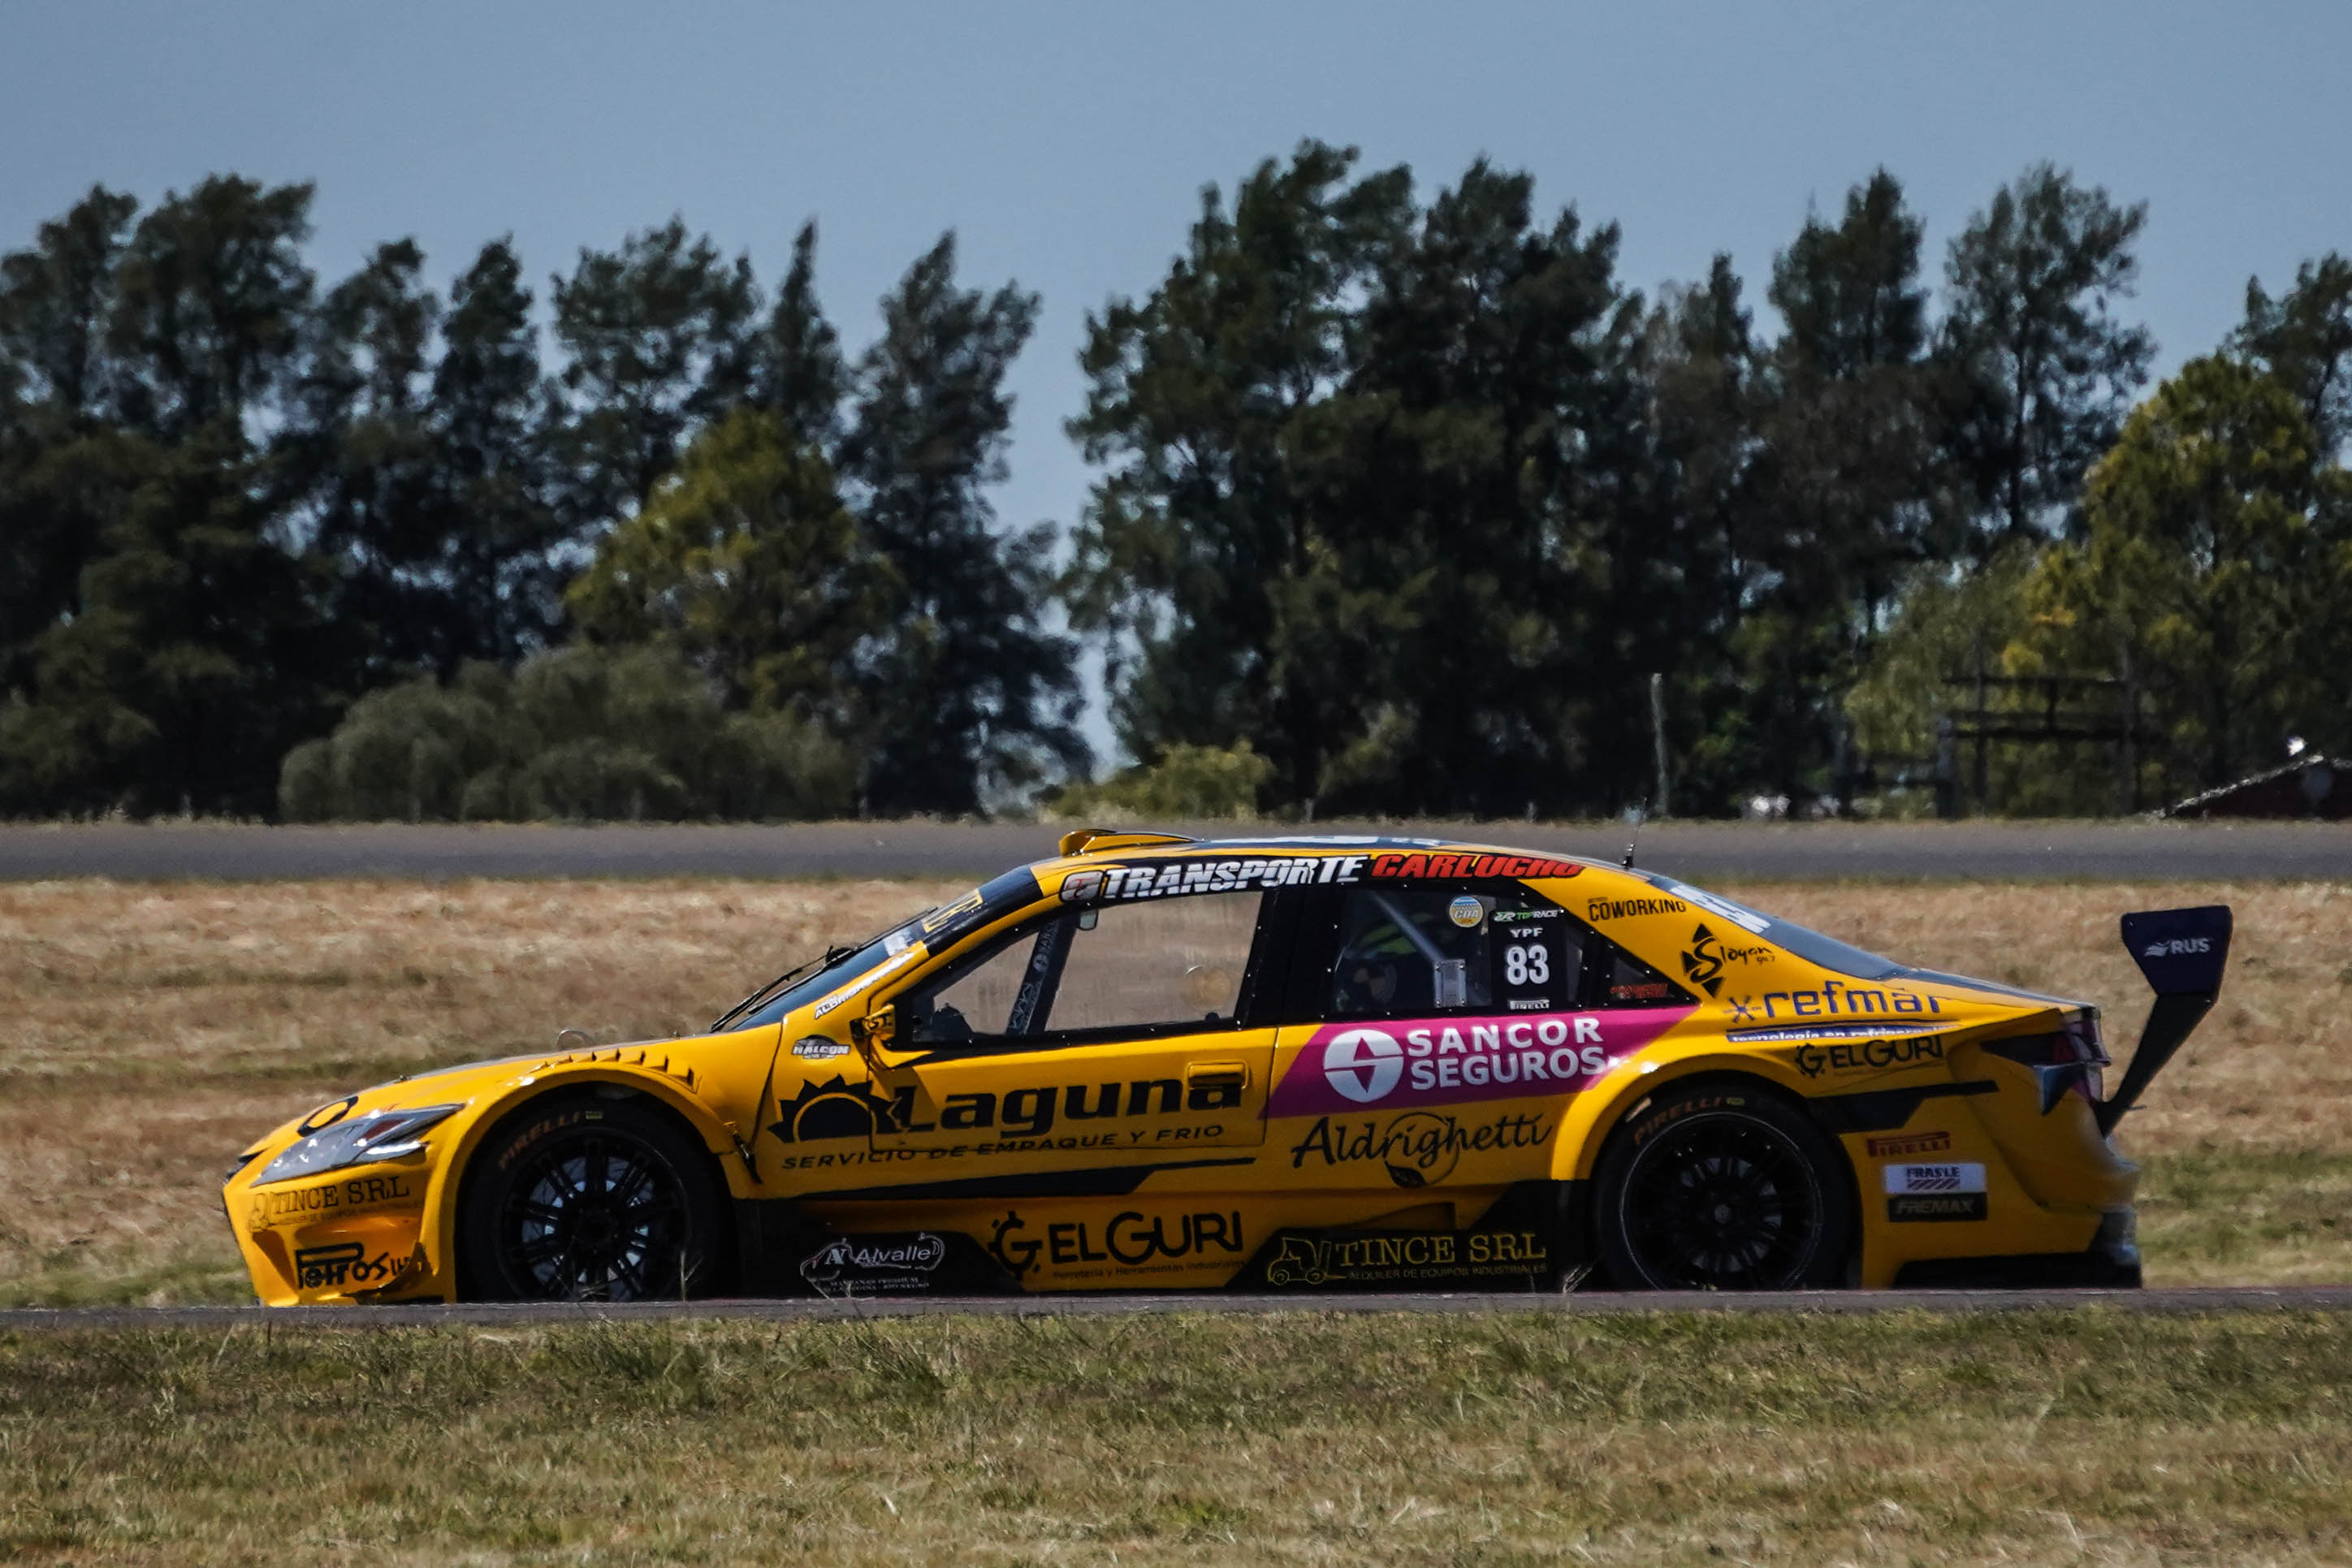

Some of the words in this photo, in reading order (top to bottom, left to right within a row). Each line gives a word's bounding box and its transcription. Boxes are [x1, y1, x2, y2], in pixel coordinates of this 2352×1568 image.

[1104, 856, 1369, 900] TRANSPORTE
[1371, 853, 1585, 879] CARLUCHO
[1589, 899, 1686, 922] COWORKING
[1510, 927, 1543, 938] YPF
[2169, 937, 2211, 954] RUS
[1507, 944, 1550, 986] 83
[1509, 999, 1550, 1010] PIRELLI
[1762, 979, 1941, 1018] refmar
[1407, 1017, 1604, 1057] SANCOR
[1410, 1046, 1606, 1091] SEGUROS
[897, 1080, 1242, 1138] Laguna
[781, 1149, 915, 1170] SERVICIO
[927, 1146, 964, 1160] DE
[977, 1133, 1115, 1155] EMPAQUE
[1129, 1130, 1144, 1143] Y
[1156, 1125, 1224, 1142] FRIO
[1291, 1112, 1553, 1169] Aldrighetti
[1867, 1131, 1951, 1156] PIRELLI
[348, 1176, 410, 1204] SRL
[1896, 1199, 1975, 1213] FREMAX
[854, 1246, 932, 1264] Alvalle
[1336, 1236, 1455, 1267] TINCE
[1470, 1233, 1546, 1263] SRL
